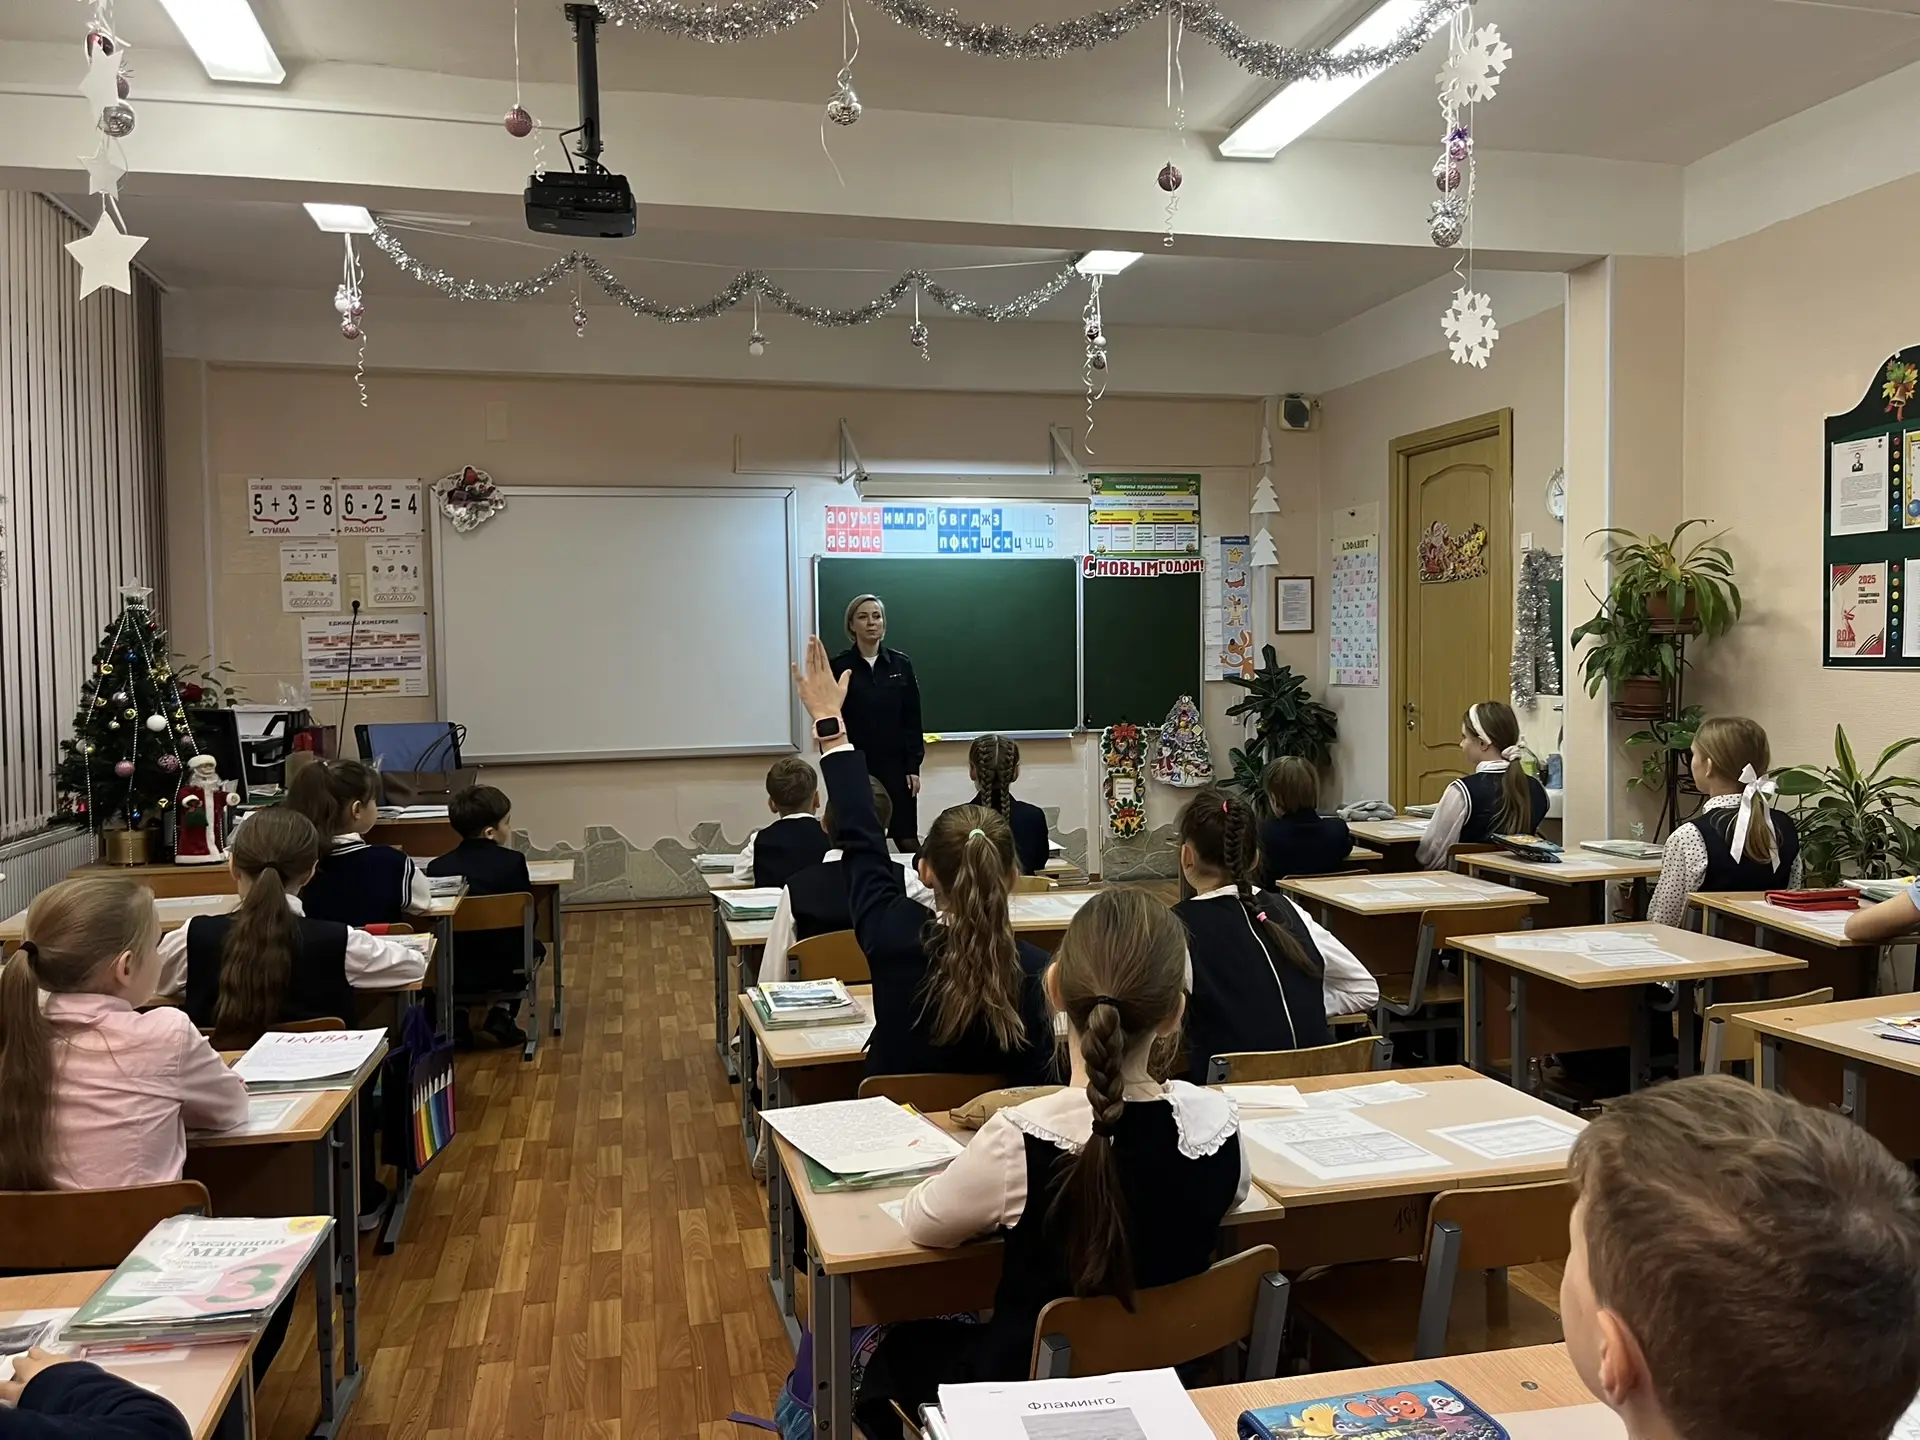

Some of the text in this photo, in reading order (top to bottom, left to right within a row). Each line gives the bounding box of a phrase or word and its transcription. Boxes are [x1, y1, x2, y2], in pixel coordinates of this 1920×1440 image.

[254, 493, 263, 515] 5
[288, 493, 298, 516] 3
[323, 493, 332, 516] 8
[345, 493, 354, 515] 6
[374, 493, 383, 514] 2
[408, 493, 417, 515] 4
[1084, 556, 1205, 577] С НОВЫМ ГОДОМ!
[1858, 575, 1876, 584] 2025
[185, 1247, 258, 1257] МИР
[205, 1263, 284, 1303] 3
[1027, 1397, 1116, 1410] Фламинго
